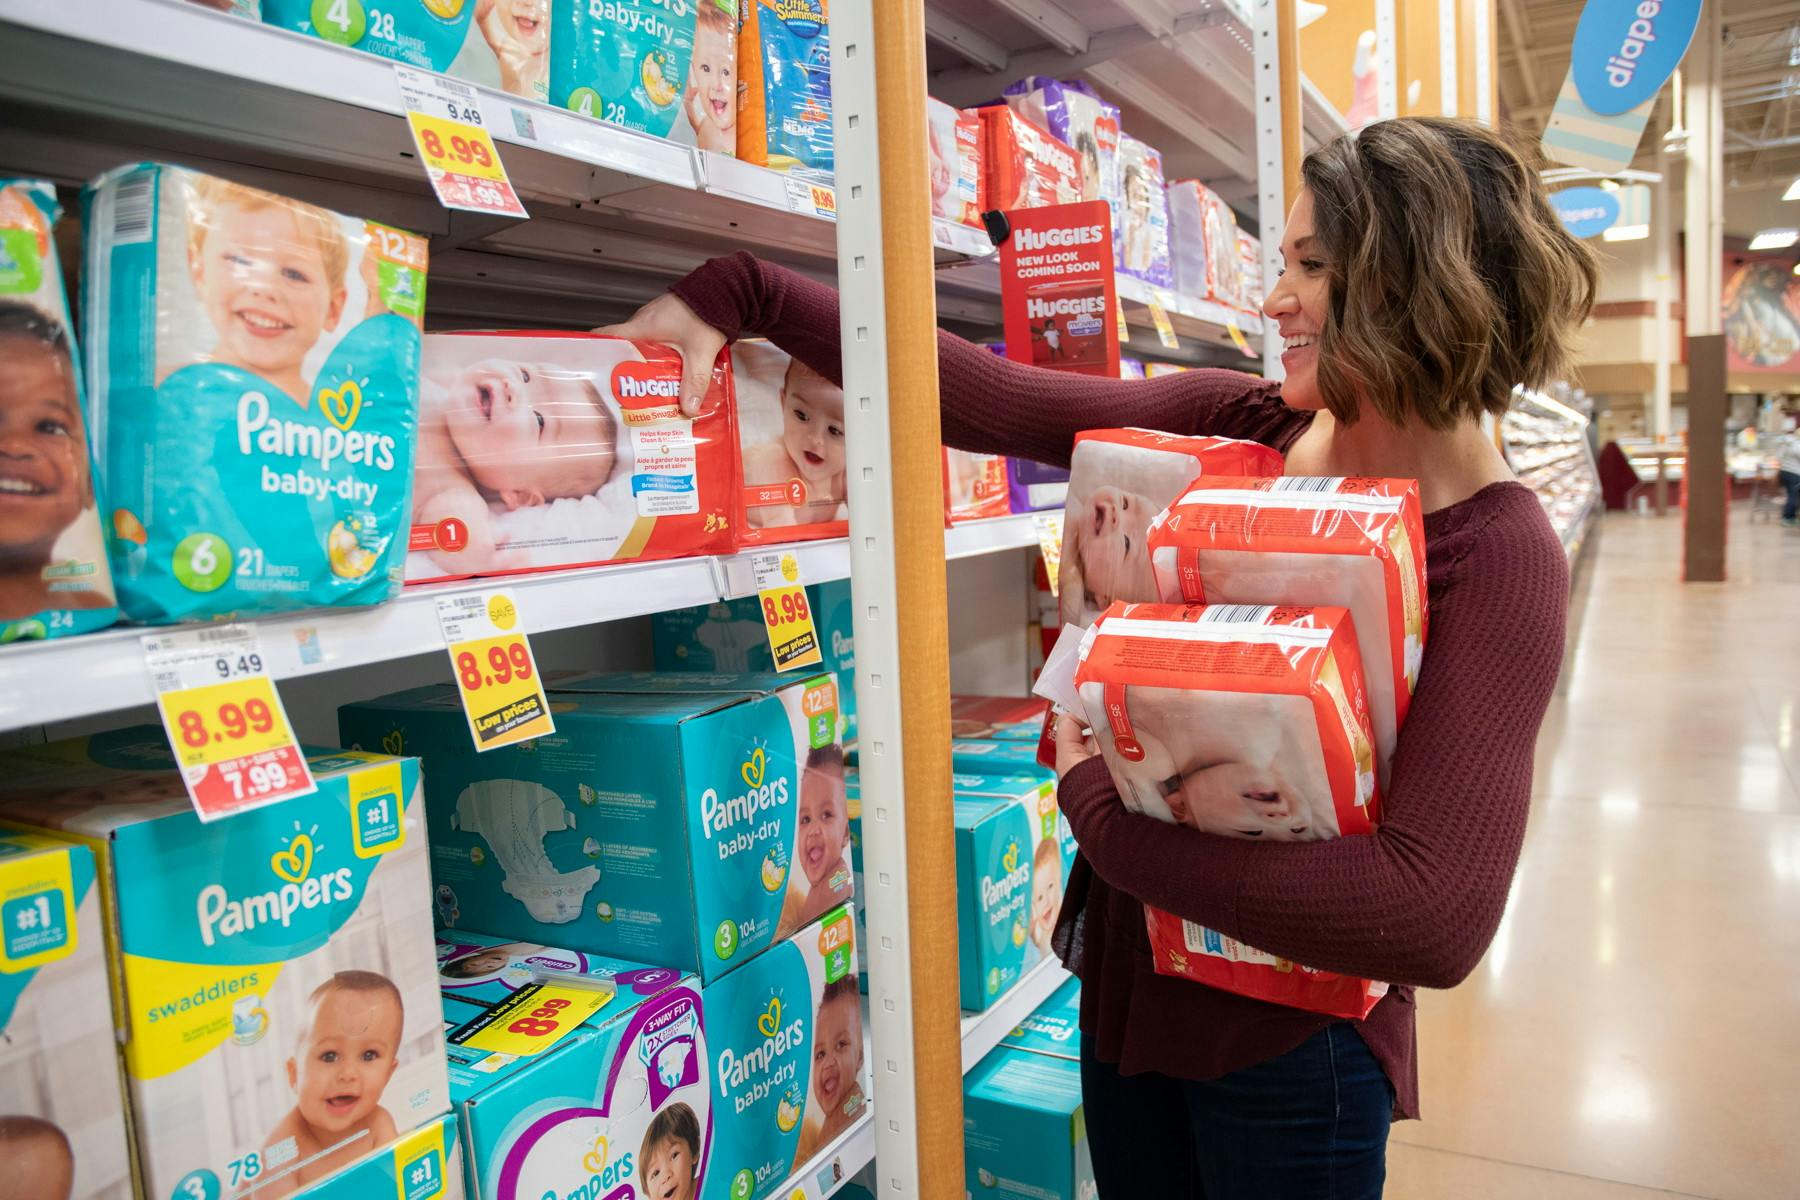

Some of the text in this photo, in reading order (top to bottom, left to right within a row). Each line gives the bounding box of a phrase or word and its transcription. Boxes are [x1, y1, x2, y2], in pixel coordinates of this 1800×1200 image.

[327, 0, 351, 32] 4
[369, 9, 396, 41] 28
[589, 0, 674, 44] baby-dry
[1605, 0, 1661, 88] diape
[666, 52, 676, 64] 12
[448, 104, 482, 125] 9.49
[578, 94, 593, 116] 4
[604, 102, 626, 126] 28
[421, 129, 493, 167] 8.99
[811, 188, 835, 209] 9.99
[375, 228, 405, 260] 12
[1014, 225, 1104, 251] HUGGIES
[1017, 252, 1078, 267] NEW LOOK
[1017, 261, 1100, 278] COMING SOON
[1027, 296, 1105, 319] HUGGIES
[619, 376, 681, 397] HUGGIE
[628, 411, 651, 423] Little
[237, 391, 395, 471] Pampers
[261, 464, 378, 506] baby-dry
[760, 491, 770, 500] 32
[792, 484, 800, 498] 2
[363, 516, 378, 528] 12
[446, 523, 457, 541] 1
[190, 539, 218, 575] 6
[236, 548, 264, 576] 21
[1184, 566, 1195, 580] 35
[49, 611, 74, 628] 24
[763, 592, 809, 627] 8.99
[775, 634, 812, 657] Low prices
[216, 654, 263, 678] 9.49
[457, 642, 532, 691] 8.99
[808, 690, 823, 712] 12
[1111, 704, 1122, 717] 35
[178, 698, 273, 748] 8.99
[476, 698, 538, 732] Low prices
[1124, 745, 1140, 754] 1
[223, 762, 288, 800] 7.99
[367, 799, 389, 825] #1
[701, 776, 789, 840] Pampers
[718, 818, 781, 860] baby-dry
[776, 842, 784, 851] 12
[982, 862, 1030, 912] Pampers
[16, 896, 51, 930] #1
[197, 868, 353, 947] Pampers
[990, 892, 1026, 927] baby-dry
[720, 924, 732, 948] 3
[739, 918, 756, 939] 104
[823, 927, 838, 950] 12
[639, 974, 661, 983] 5
[148, 972, 259, 1023] swaddlers
[454, 1025, 476, 1042] Fresh
[490, 1003, 511, 1017] Low
[508, 999, 572, 1037] 899
[648, 1002, 687, 1032] 3-WAY FIT
[647, 1013, 691, 1054] 2X STRETCHIER
[718, 1019, 804, 1097] Pampers
[734, 1060, 796, 1114] baby-dry
[792, 1082, 799, 1092] 12
[227, 1152, 261, 1186] 78
[411, 1157, 432, 1185] #1
[755, 1161, 772, 1184] 104
[184, 1176, 207, 1200] 3
[736, 1174, 748, 1197] 3
